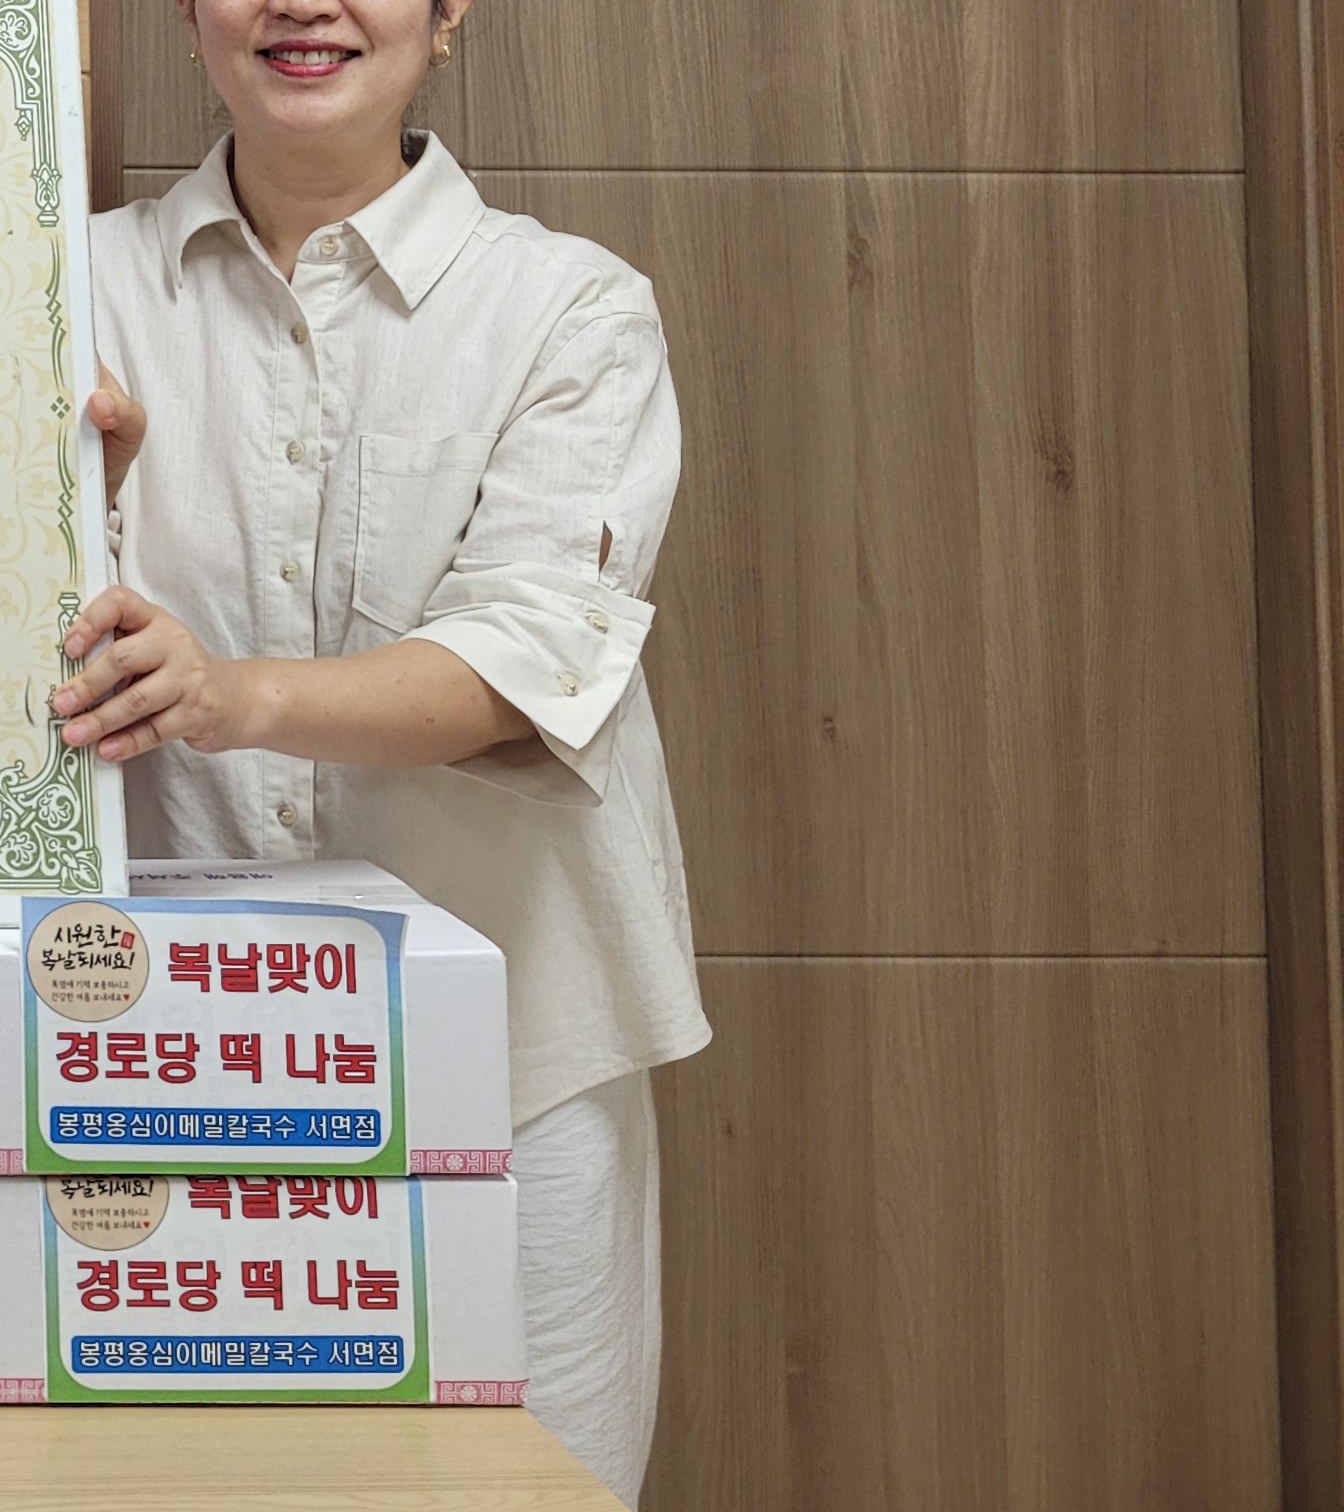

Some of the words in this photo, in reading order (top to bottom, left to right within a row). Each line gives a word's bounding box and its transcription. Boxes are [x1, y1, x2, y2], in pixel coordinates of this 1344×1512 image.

[168, 939, 356, 998] 복날맞이
[56, 1031, 200, 1084] 경로당
[220, 1033, 262, 1083] 떡
[285, 1034, 377, 1084] 나눔
[58, 1113, 295, 1138] 봉평옹심이메밀칼국수
[306, 1111, 381, 1138] 서면점
[77, 1260, 221, 1312] 경로당
[241, 1259, 283, 1310] 떡
[307, 1259, 399, 1310] 나눔
[79, 1341, 317, 1366] 봉평옹심이메밀칼국수
[329, 1340, 403, 1372] 서면점
